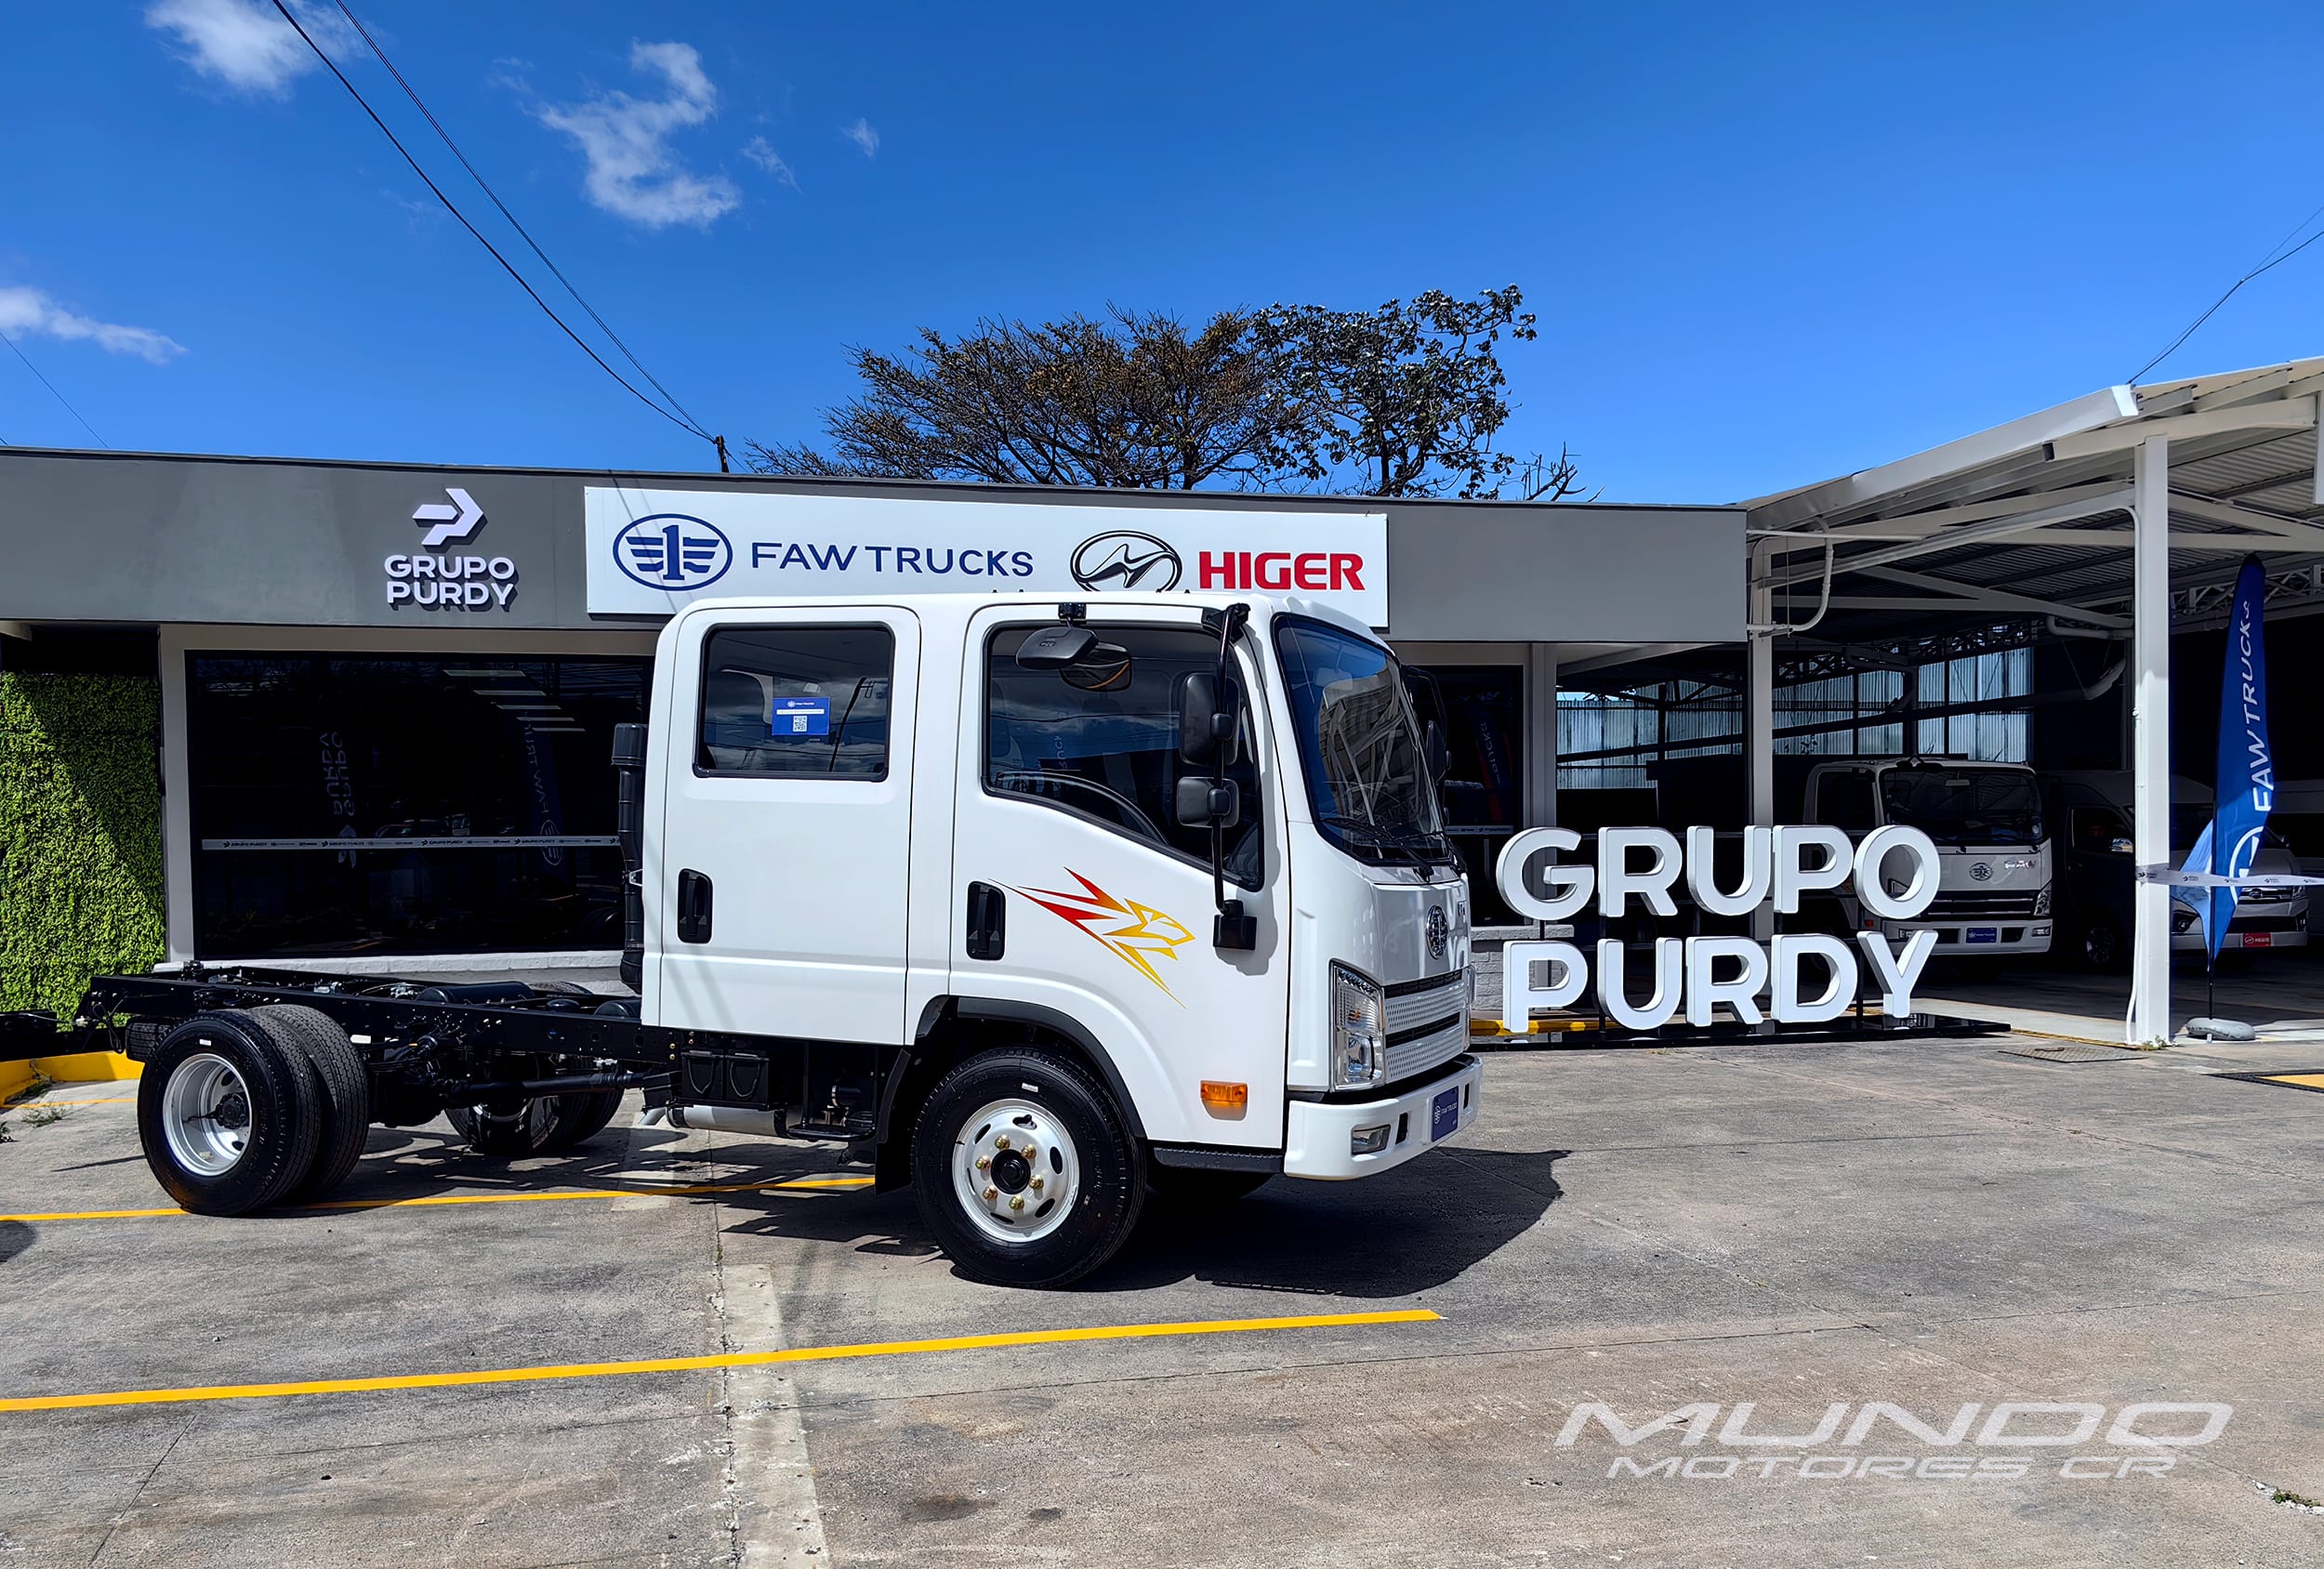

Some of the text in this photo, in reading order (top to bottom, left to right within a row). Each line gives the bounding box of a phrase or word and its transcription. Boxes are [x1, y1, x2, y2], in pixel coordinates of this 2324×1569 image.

[384, 554, 517, 581] GRUPO
[752, 542, 1034, 577] FAW TRUCKS
[1199, 551, 1366, 590] HIGER
[386, 580, 519, 607] PURDY
[2239, 600, 2275, 812] FAW TRUCKS
[1497, 824, 1941, 920] GRUPO
[1501, 930, 1939, 1035] PURDY
